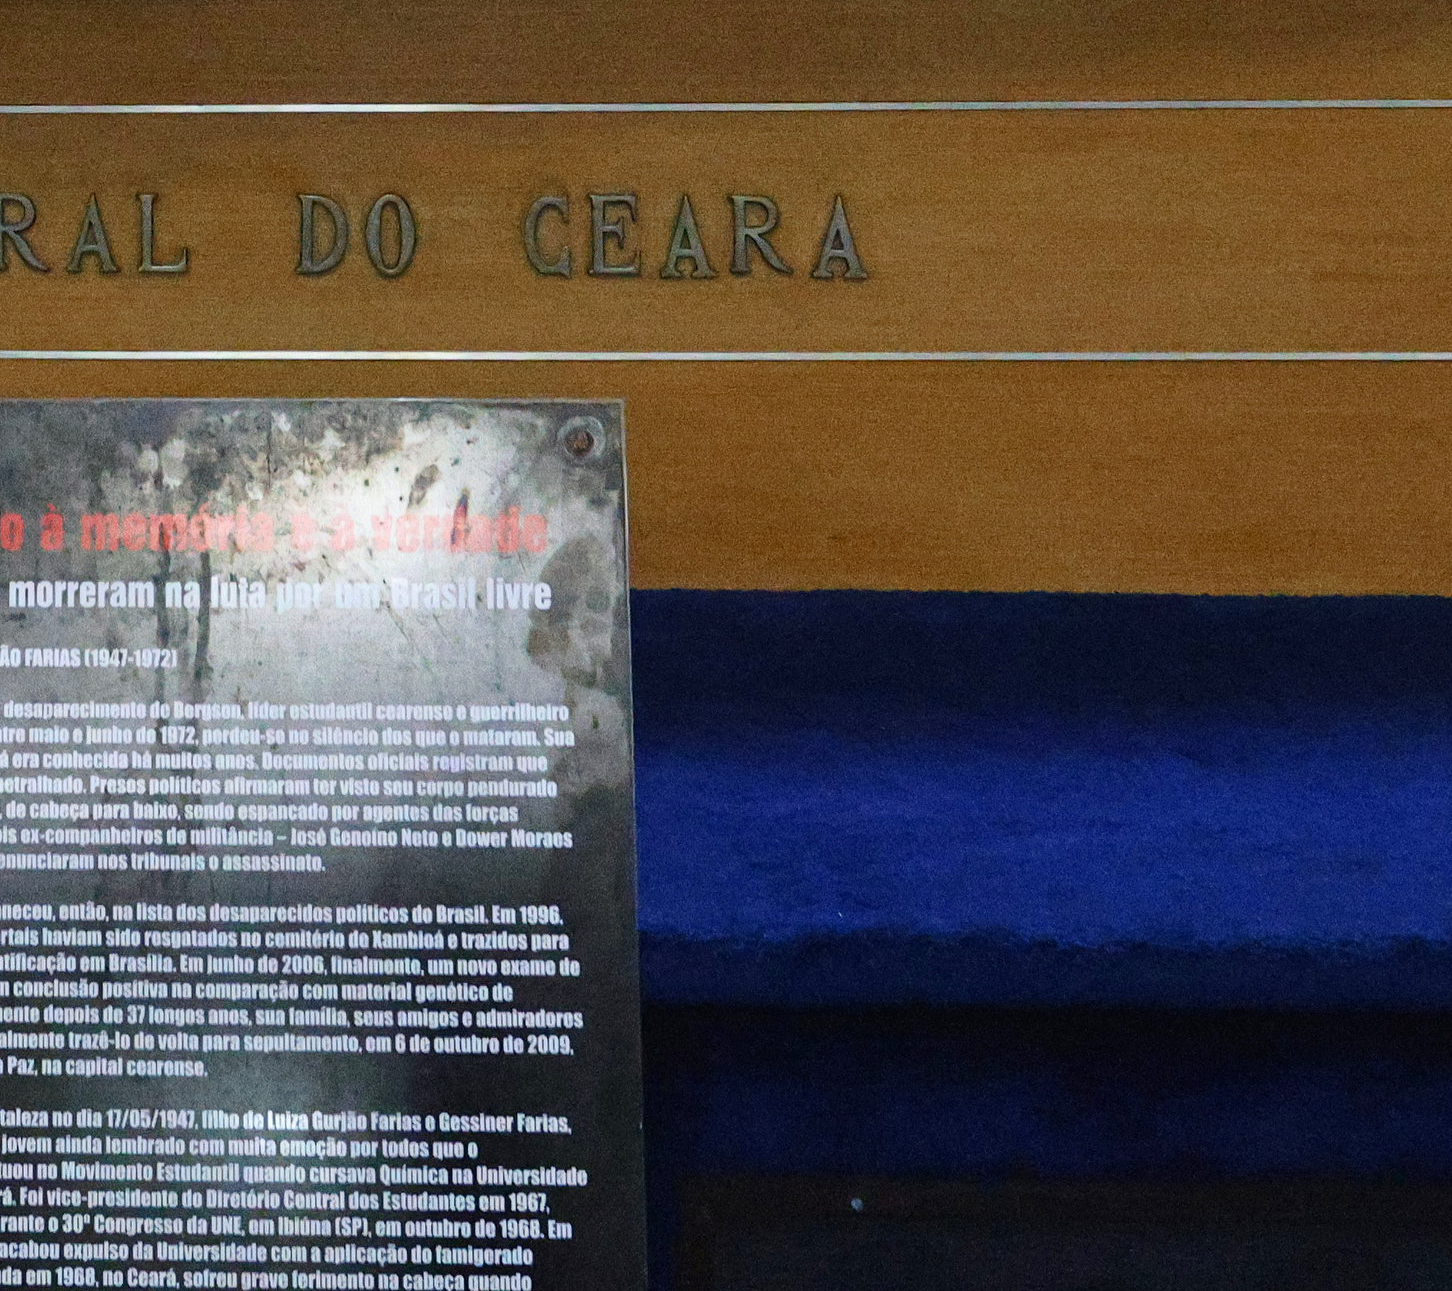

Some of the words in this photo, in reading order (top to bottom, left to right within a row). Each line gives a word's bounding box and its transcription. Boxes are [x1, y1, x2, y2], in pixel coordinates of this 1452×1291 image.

[296, 192, 418, 278] DO
[522, 193, 869, 279] CEARA
[40, 503, 64, 551] à
[79, 501, 274, 553] memória
[290, 513, 316, 552] e
[371, 506, 548, 553] verdade
[8, 578, 154, 608] morreram
[165, 578, 200, 608] na
[211, 576, 266, 609] luta
[276, 581, 322, 615] por
[335, 581, 380, 609] um
[392, 578, 476, 610] Brasil
[487, 577, 552, 610] livre
[25, 648, 81, 667] FARIAS
[85, 648, 178, 669] (1947-1972)
[90, 777, 147, 794] Presos
[149, 776, 221, 798] políticos
[223, 777, 310, 795] afirmaram
[313, 778, 337, 795] ter
[339, 778, 381, 795] visto
[383, 781, 414, 796] seu
[416, 781, 465, 799] corpo
[467, 778, 558, 799] pendurado
[97, 855, 128, 869] nos
[130, 852, 206, 870] tribunais
[112, 906, 134, 921] na
[136, 903, 173, 922] lista
[176, 903, 206, 922] dos
[209, 903, 333, 925] desaparecidos
[335, 903, 409, 926] políticos
[491, 905, 517, 924] Em
[12, 978, 99, 997] conclusão
[102, 979, 169, 1000] positiva
[171, 983, 193, 998] na
[195, 979, 299, 1001] comparação
[301, 984, 339, 999] com
[341, 981, 412, 999] material
[415, 981, 489, 1002] genético
[41, 1061, 63, 1075] na
[65, 1058, 123, 1078] capital
[51, 1112, 73, 1127] no
[76, 1109, 104, 1128] dia
[201, 1110, 240, 1129] filho
[267, 1111, 309, 1130] Luiza
[311, 1110, 368, 1133] Gurjão
[370, 1112, 422, 1131] Farias
[438, 1112, 514, 1132] Gessiner
[1, 1135, 53, 1156] jovem
[54, 1135, 103, 1154] ainda
[105, 1136, 186, 1155] lembrado
[188, 1140, 225, 1155] com
[228, 1137, 277, 1156] muita
[279, 1137, 347, 1159] emoção
[350, 1142, 379, 1160] por
[381, 1139, 430, 1157] todos
[432, 1143, 465, 1161] que
[19, 1187, 44, 1206] Foi
[46, 1188, 179, 1210] vice-presidente
[205, 1189, 281, 1208] Diretório
[283, 1191, 346, 1209] Central
[347, 1191, 380, 1210] dos
[382, 1192, 476, 1211] Estudantes
[478, 1196, 506, 1211] em
